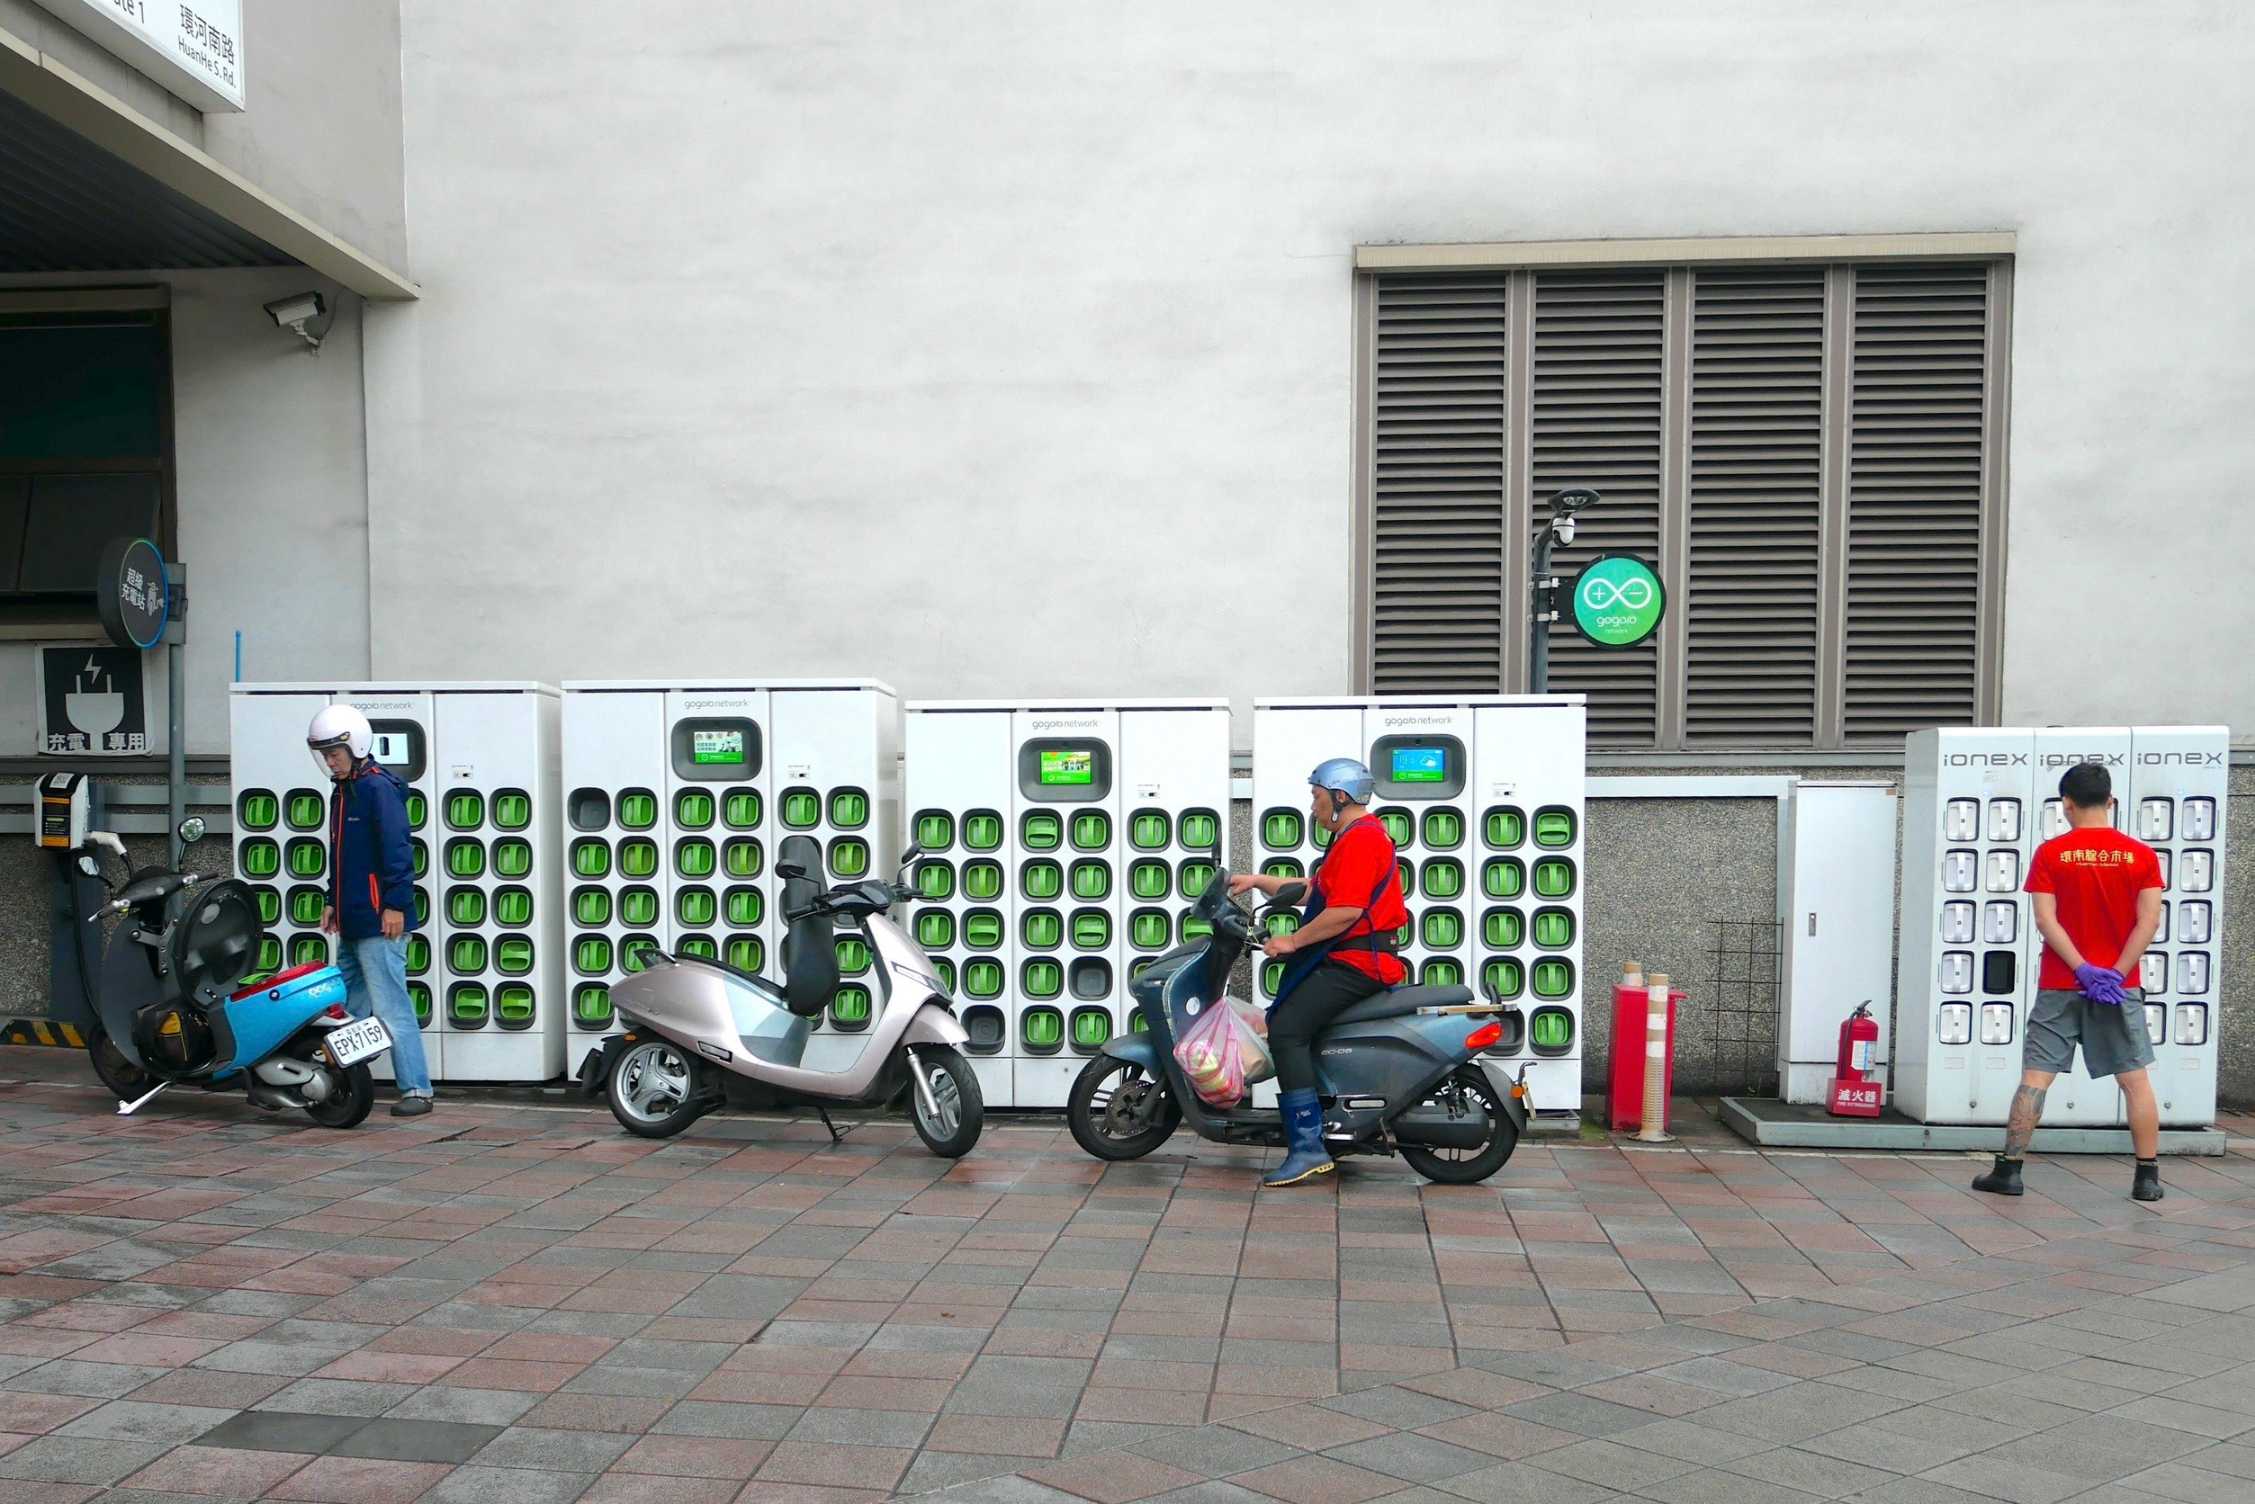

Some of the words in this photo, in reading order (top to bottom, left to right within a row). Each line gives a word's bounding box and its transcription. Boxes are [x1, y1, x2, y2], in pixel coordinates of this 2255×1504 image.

[138, 1, 144, 24] 1
[180, 4, 234, 66] 環河南路
[1944, 753, 2028, 766] ionex
[2137, 752, 2222, 765] ionex
[334, 1025, 383, 1057] EPX-7159
